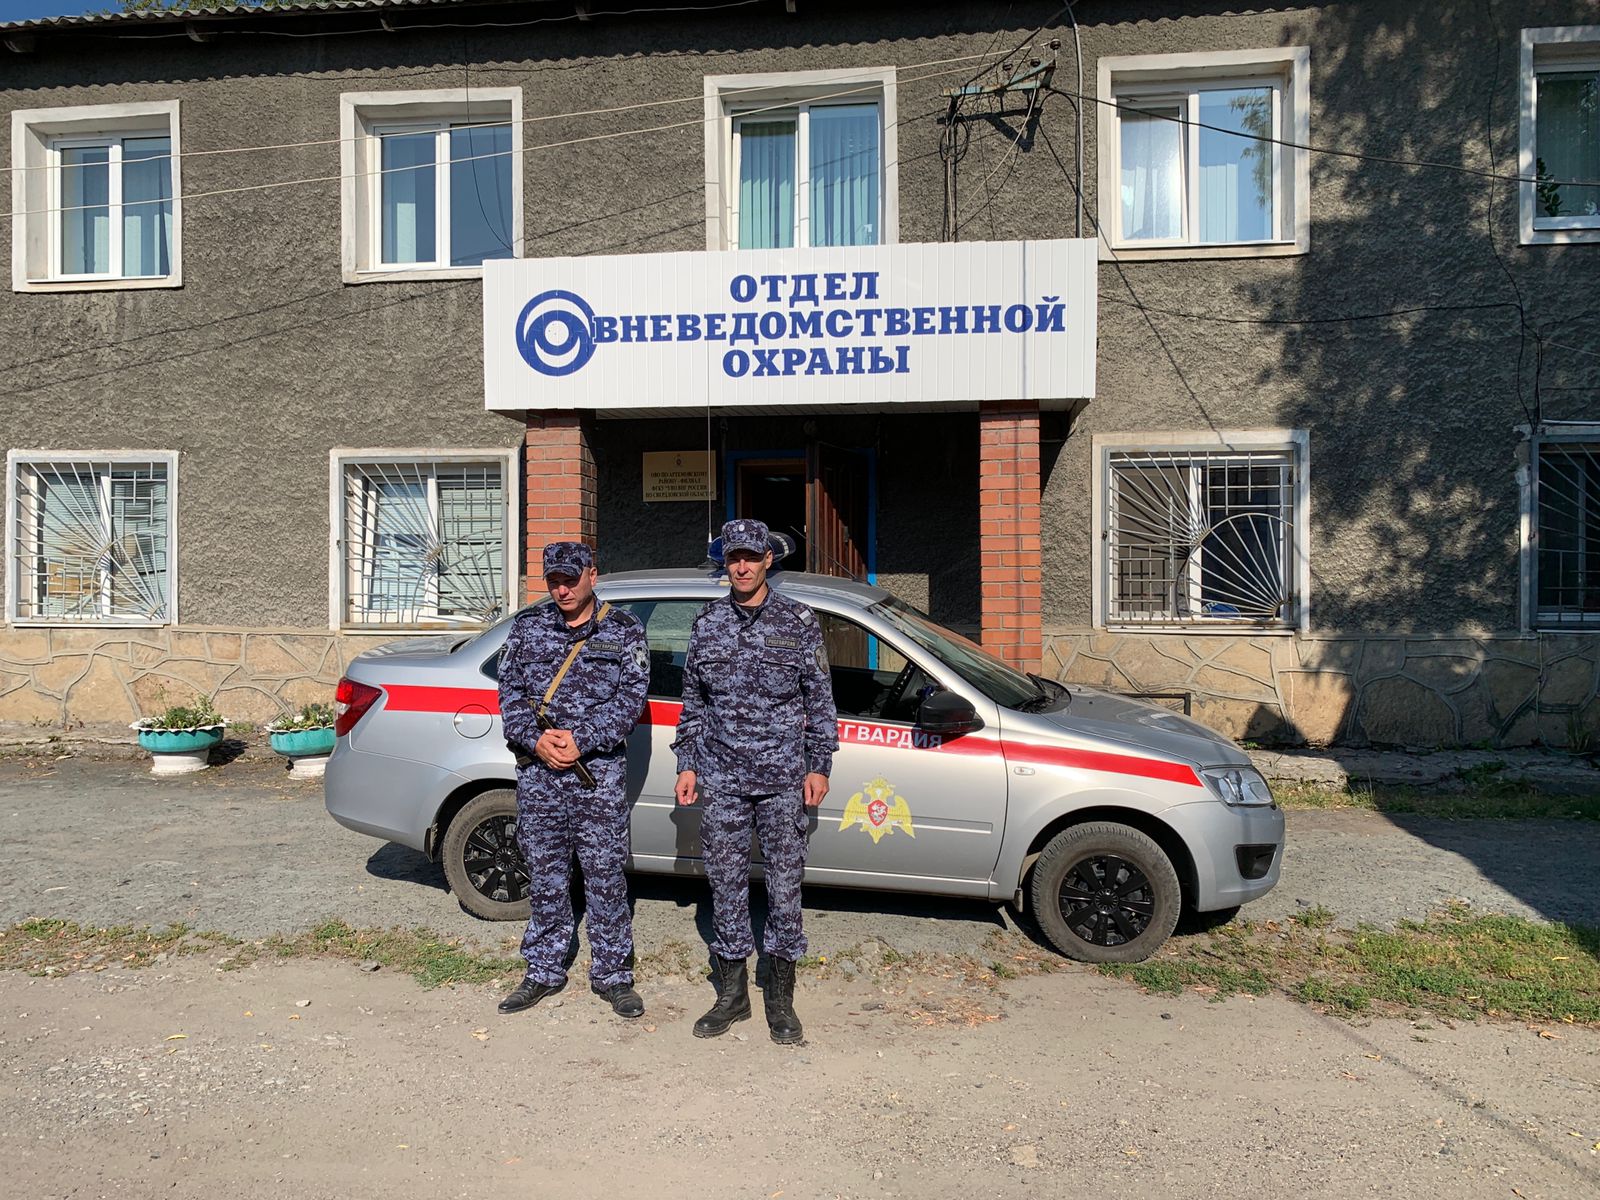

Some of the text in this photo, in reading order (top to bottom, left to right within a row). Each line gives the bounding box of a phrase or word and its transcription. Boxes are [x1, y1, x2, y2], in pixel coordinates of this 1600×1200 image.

[730, 271, 879, 307] ОТДЕЛ
[592, 296, 1066, 345] ВНЕВЕДОМСТВЕННОЙ
[722, 345, 909, 378] ОХРАНЫ
